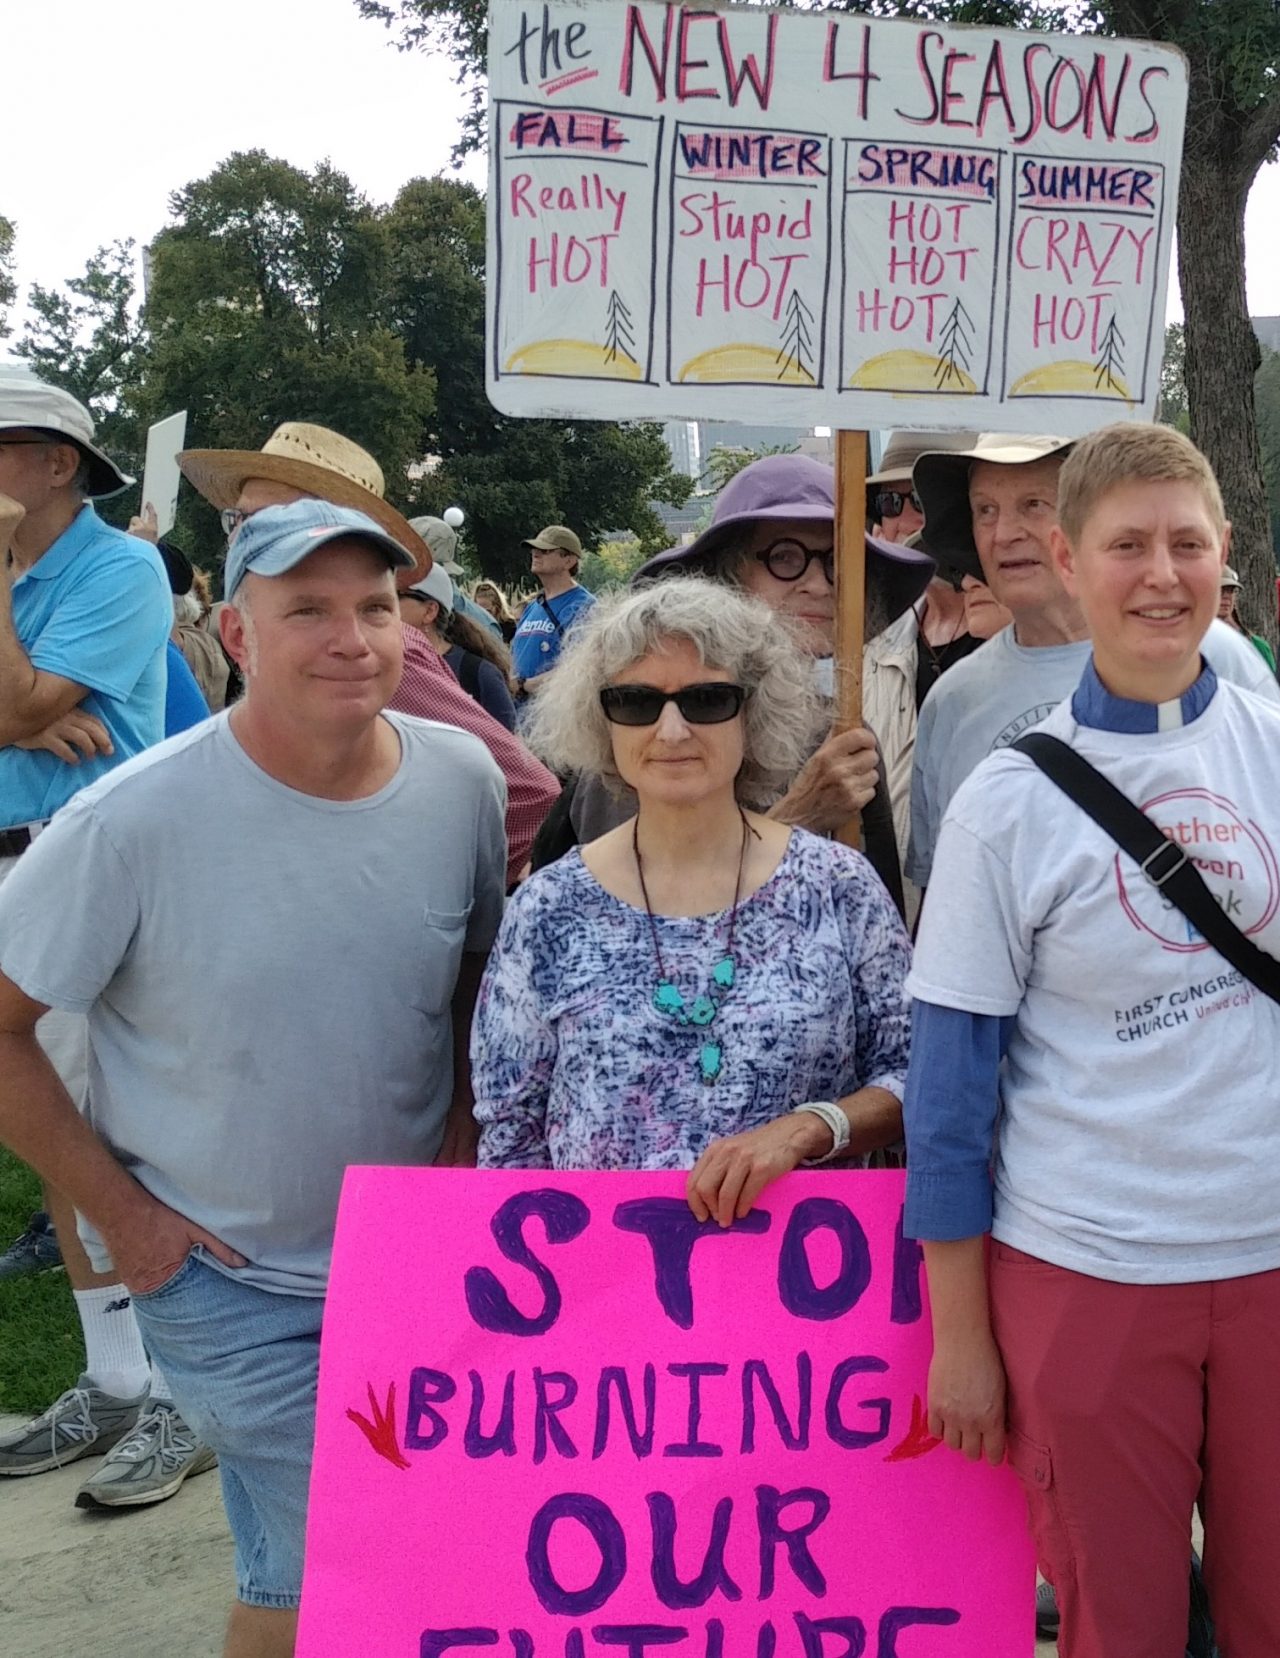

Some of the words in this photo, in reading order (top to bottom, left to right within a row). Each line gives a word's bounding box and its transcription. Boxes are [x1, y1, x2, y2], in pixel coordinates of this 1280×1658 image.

[506, 14, 590, 84] the
[620, 4, 775, 112] NEW
[823, 20, 881, 120] 4
[894, 32, 1170, 145] SEASONS
[512, 112, 630, 149] FALL
[679, 131, 824, 178] WINTER
[857, 145, 998, 197] SPRING
[1019, 158, 1154, 207] SUMMER
[510, 173, 626, 231] Really
[888, 201, 969, 243] HOT
[679, 194, 812, 266] Stupid
[1016, 214, 1155, 287] CRAZY
[528, 234, 618, 293] HOT
[697, 255, 808, 319] HOT
[888, 246, 979, 286] HOT
[857, 289, 948, 342] HOT
[1033, 293, 1114, 355] HOT
[1115, 995, 1164, 1023] FIRST
[1116, 1009, 1190, 1042] CHURCH
[404, 1351, 891, 1465] BURNING
[527, 1484, 830, 1617] OUR
